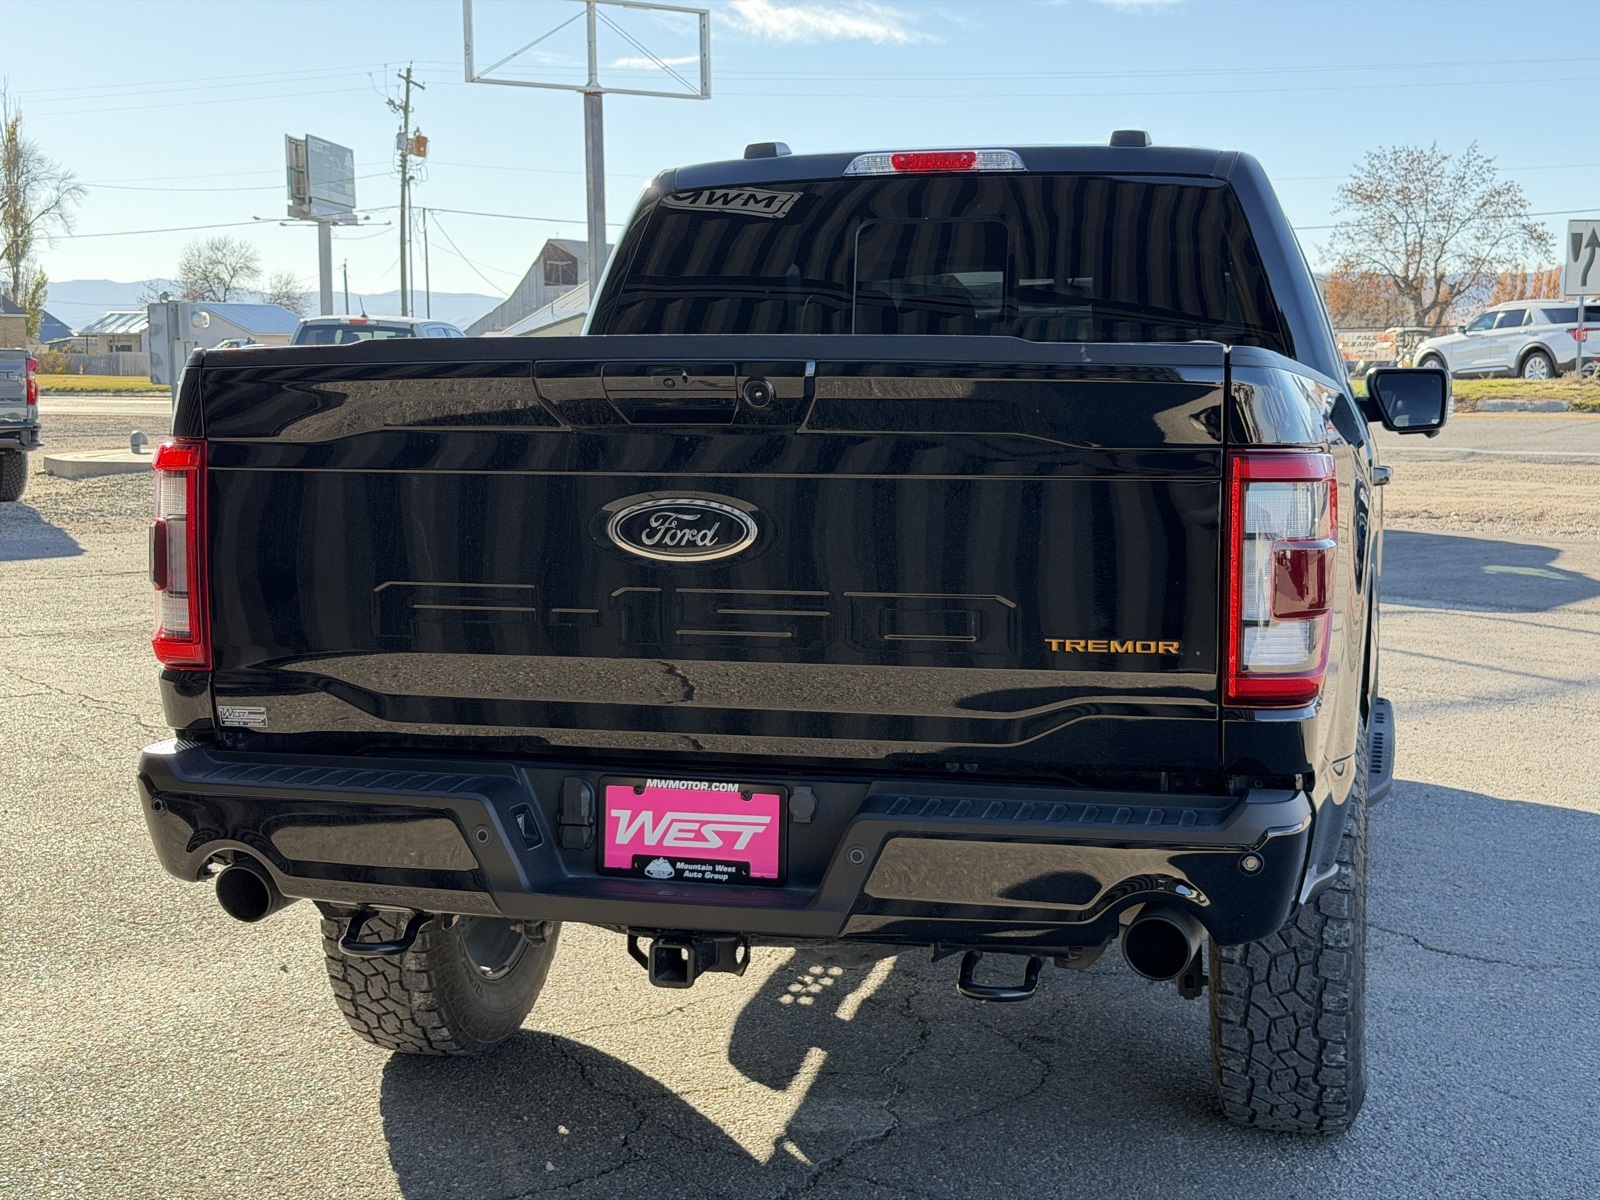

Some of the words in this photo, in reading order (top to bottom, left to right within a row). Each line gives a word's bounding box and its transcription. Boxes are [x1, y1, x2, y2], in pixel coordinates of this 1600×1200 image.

[641, 511, 721, 547] Ford
[1044, 638, 1181, 655] TREMOR
[645, 778, 739, 793] MWMOTOR.COM
[610, 809, 772, 850] WEST
[675, 861, 714, 872] Mountain
[715, 864, 737, 873] West
[683, 869, 704, 878] Auto
[705, 871, 729, 881] Group
